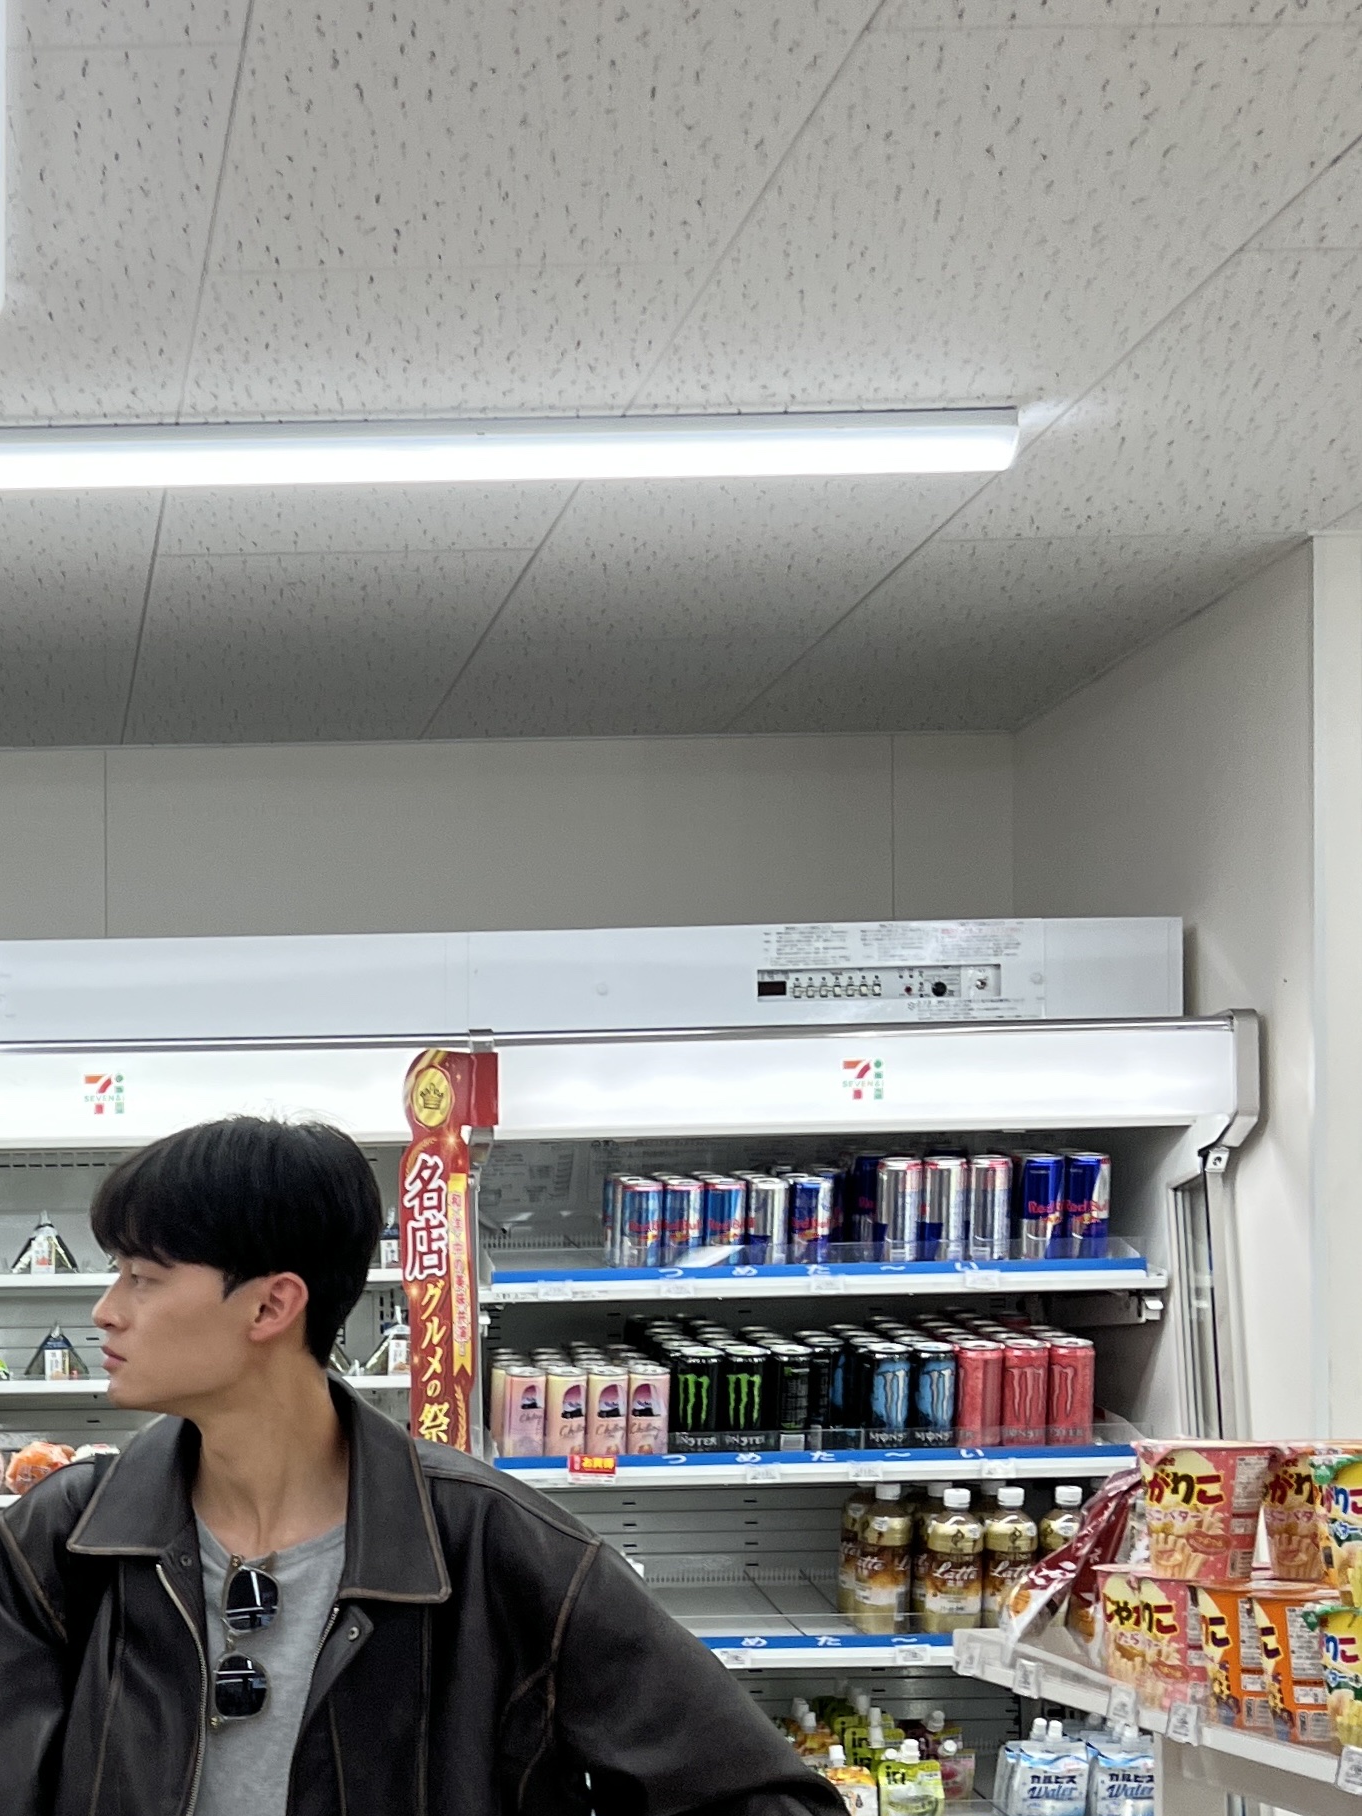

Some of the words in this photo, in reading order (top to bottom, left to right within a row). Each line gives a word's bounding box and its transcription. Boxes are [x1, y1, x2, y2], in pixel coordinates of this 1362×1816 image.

[403, 1153, 448, 1281] 名店
[1029, 1200, 1053, 1214] Red
[1148, 1468, 1225, 1504] がりこ
